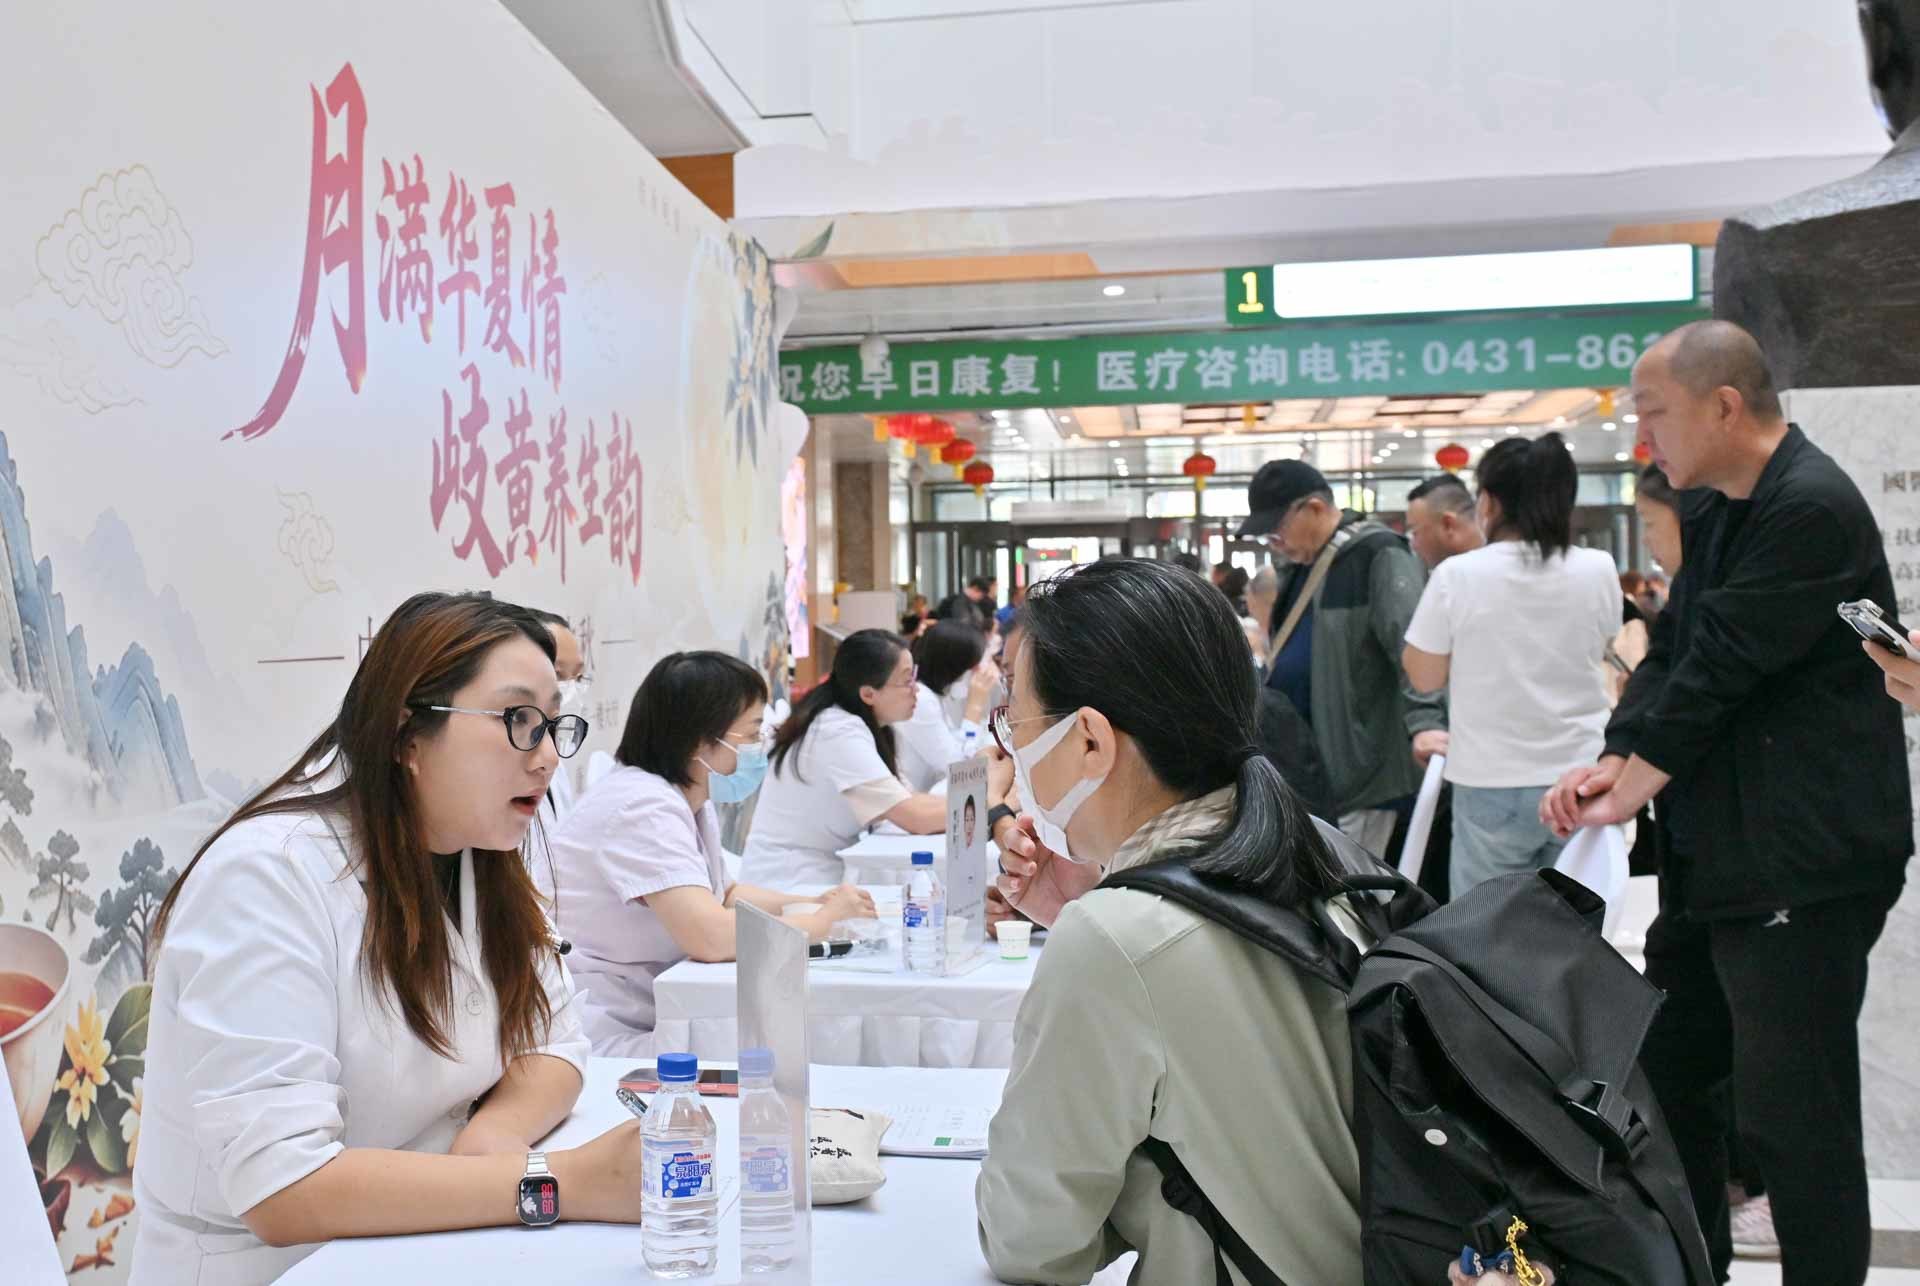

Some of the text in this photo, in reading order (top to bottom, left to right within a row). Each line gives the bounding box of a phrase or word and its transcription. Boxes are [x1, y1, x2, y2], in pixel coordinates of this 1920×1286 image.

[1238, 271, 1263, 313] 1
[675, 1162, 711, 1179] 泉阳泉
